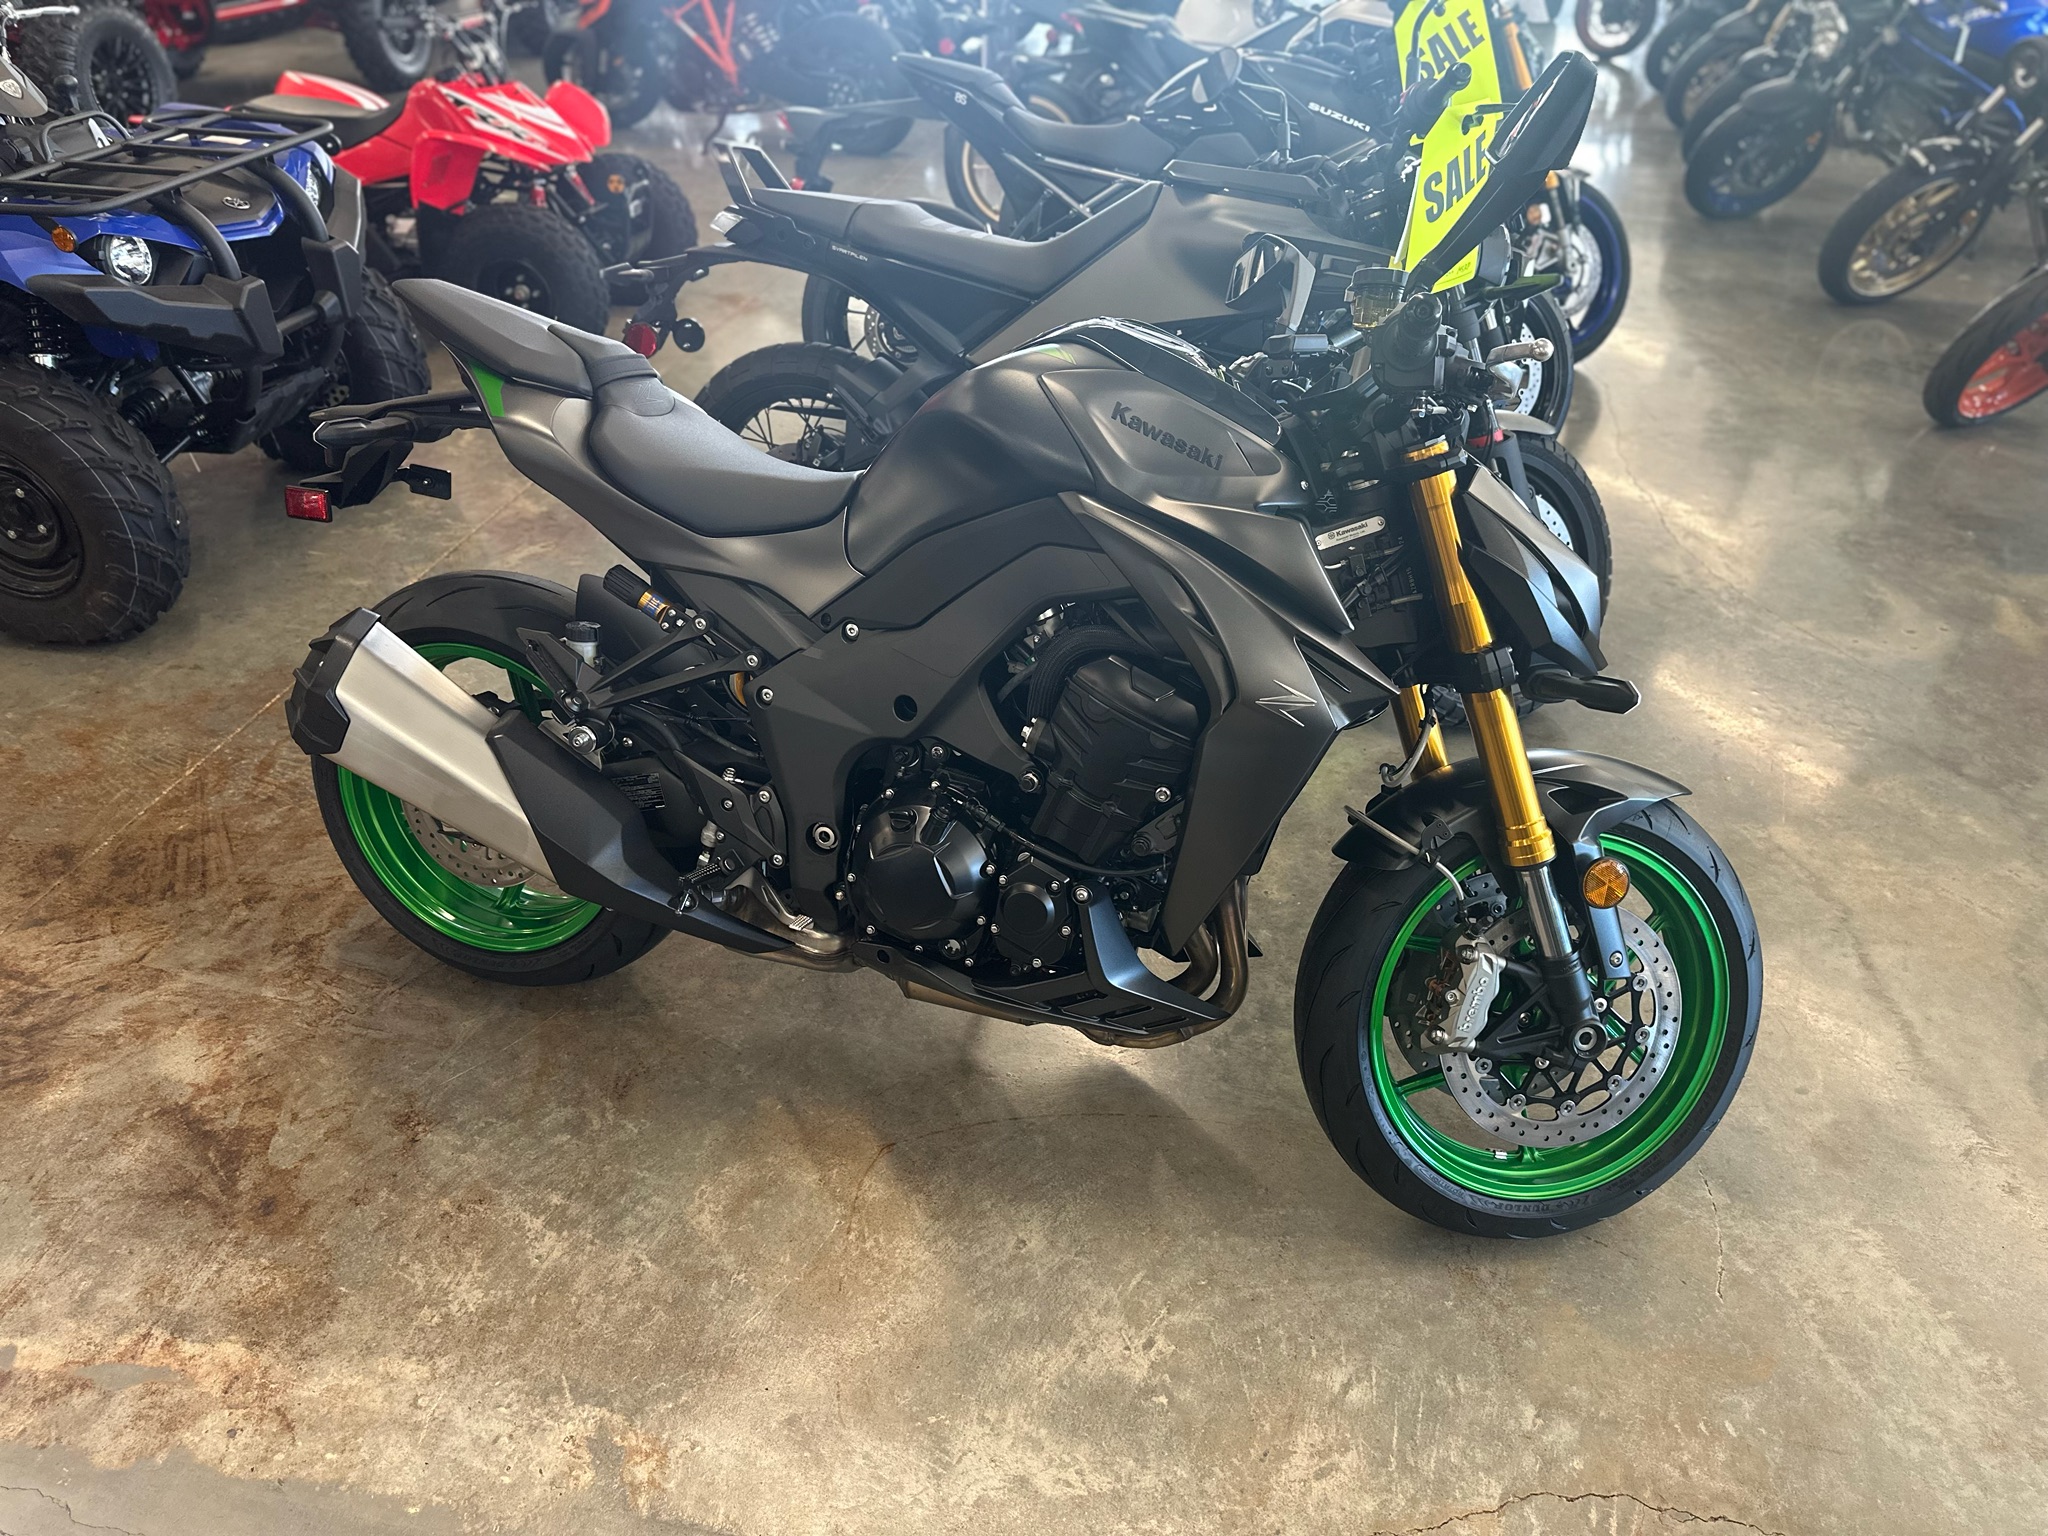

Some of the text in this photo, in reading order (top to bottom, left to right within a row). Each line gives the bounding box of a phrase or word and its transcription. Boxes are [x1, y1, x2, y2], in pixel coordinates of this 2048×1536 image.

[1307, 102, 1370, 132] SUZUKI
[1423, 130, 1486, 223] SALE
[1110, 401, 1223, 471] Kawasaki
[1335, 522, 1368, 537] Kawasaki
[1457, 976, 1490, 1032] brembo
[1495, 1203, 1550, 1213] DUNLOP
